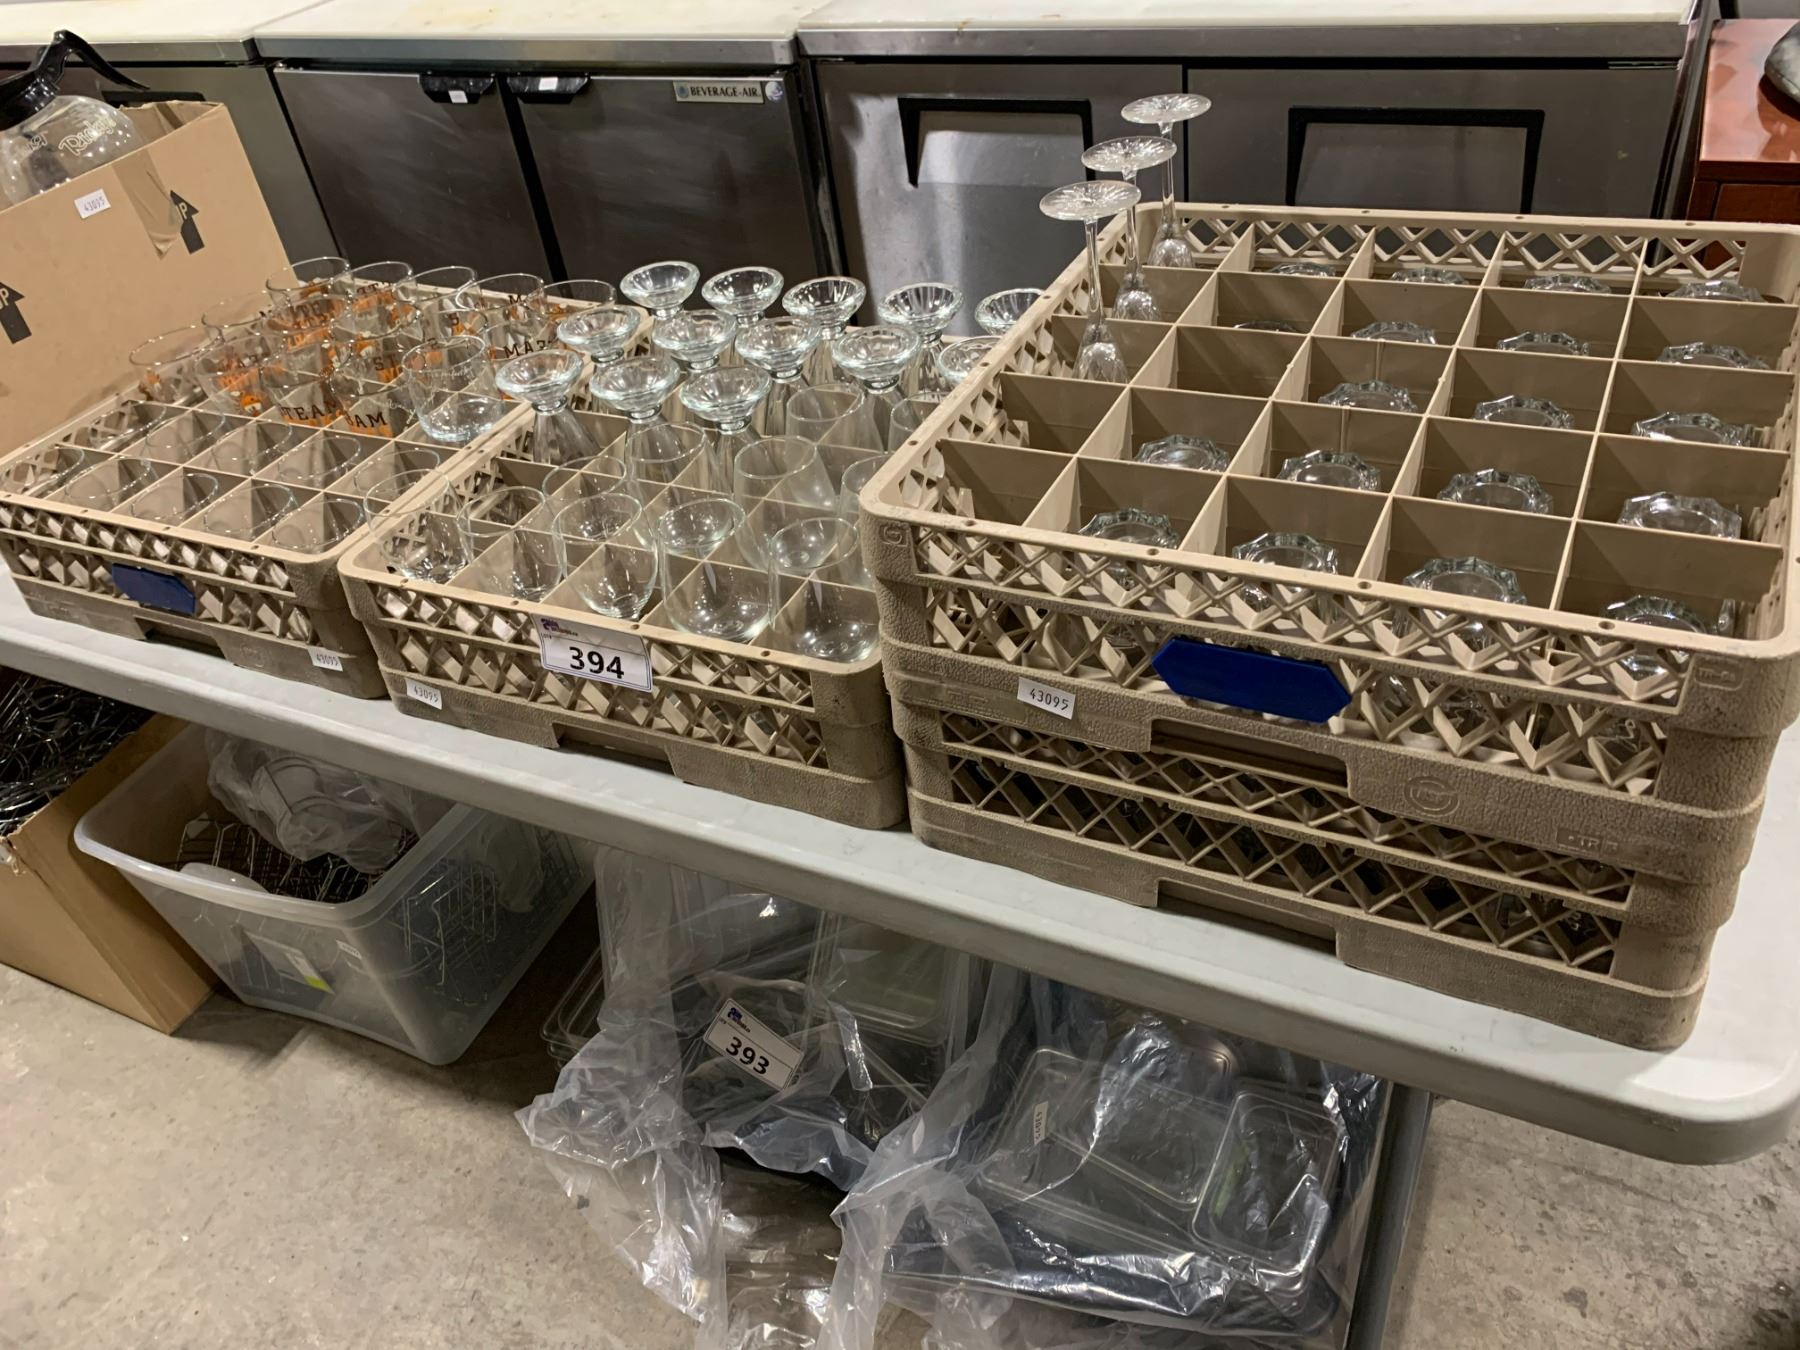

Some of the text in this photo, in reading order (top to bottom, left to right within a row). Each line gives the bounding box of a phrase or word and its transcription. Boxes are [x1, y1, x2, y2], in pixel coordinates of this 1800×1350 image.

[569, 646, 625, 679] 394
[413, 685, 439, 704] 43095
[1028, 687, 1070, 711] 43095
[725, 1036, 770, 1075] 393
